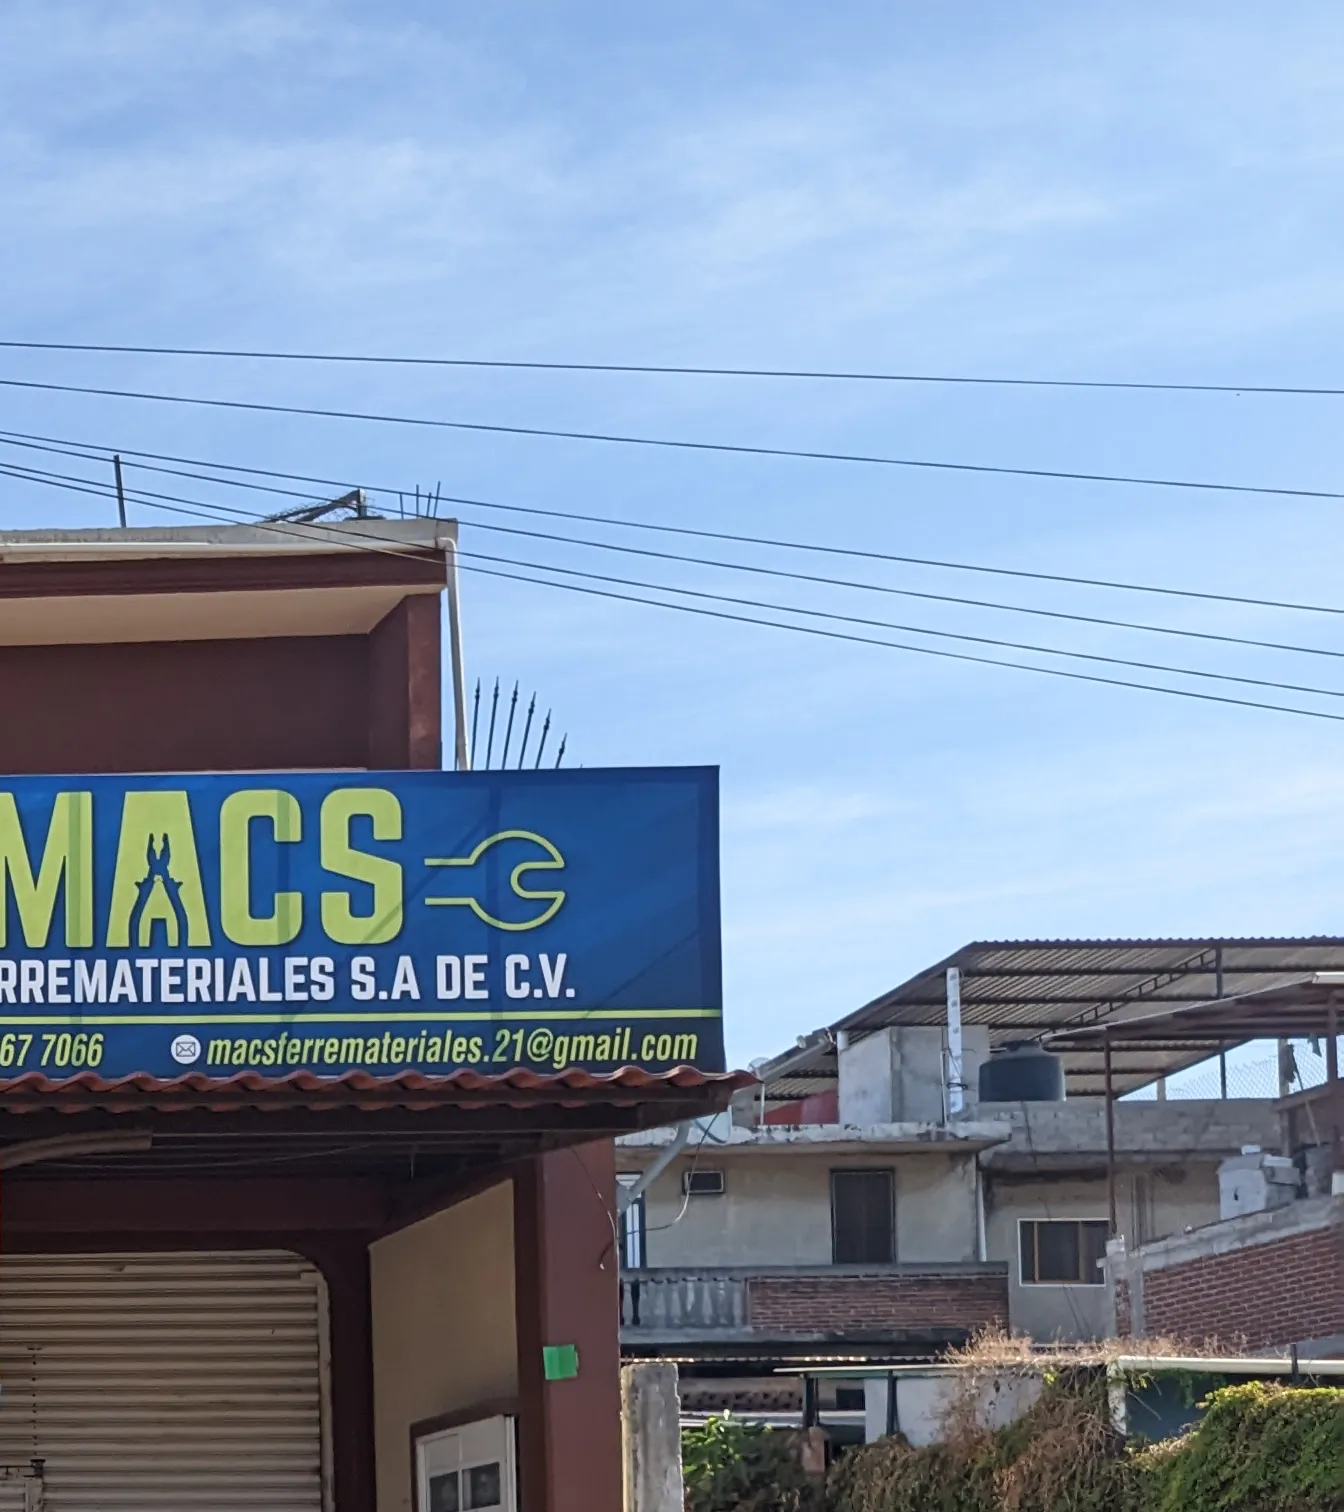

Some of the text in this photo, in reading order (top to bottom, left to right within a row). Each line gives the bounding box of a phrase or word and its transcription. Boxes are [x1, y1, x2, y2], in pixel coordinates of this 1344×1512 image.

[351, 955, 419, 1000] S.A
[436, 955, 489, 999] DE
[505, 953, 575, 998] C.V.
[41, 1032, 104, 1067] 7066
[207, 1028, 698, 1069] macsferremateriales.21@gmail.com
